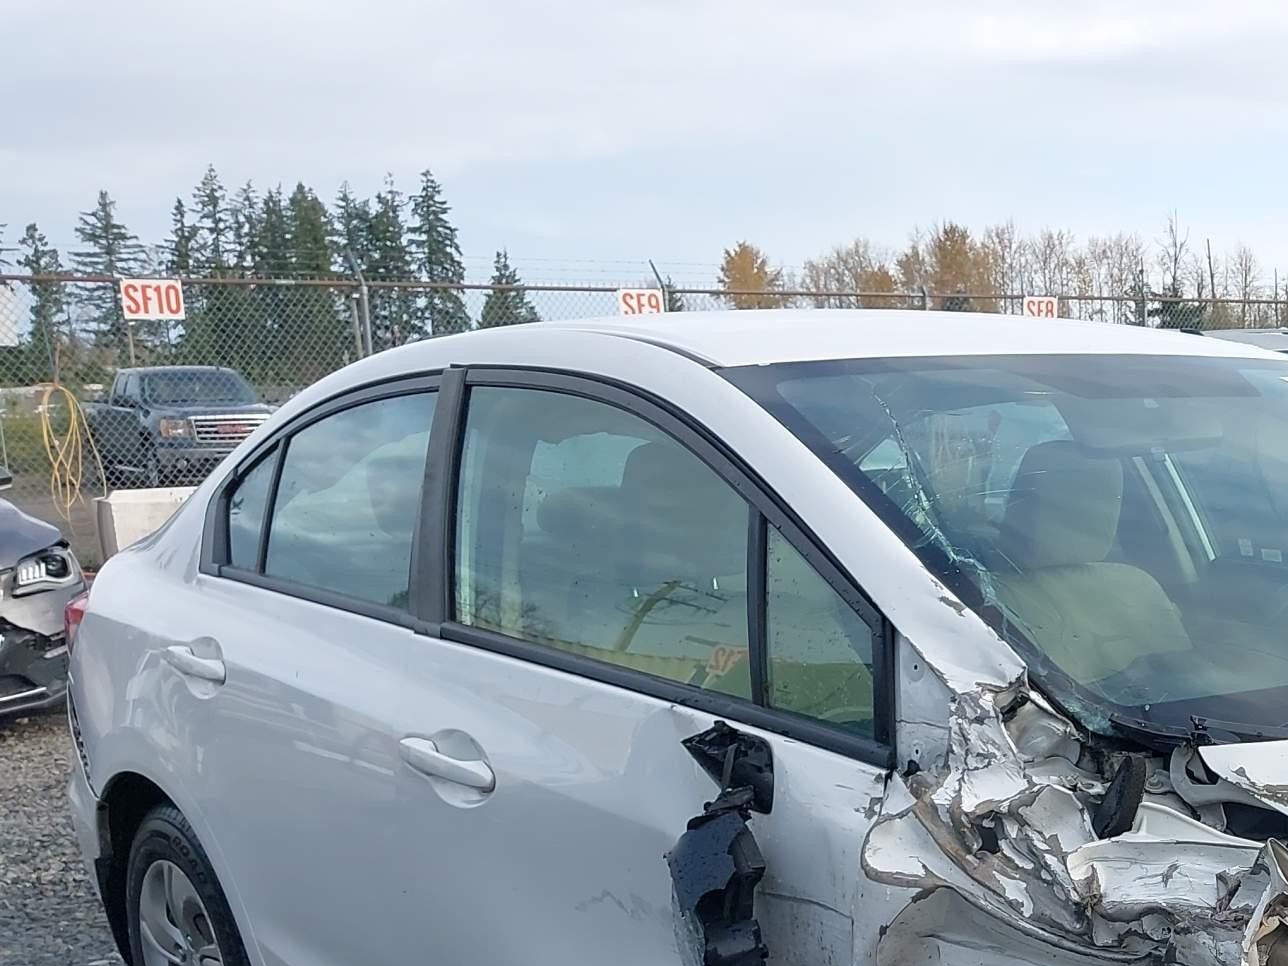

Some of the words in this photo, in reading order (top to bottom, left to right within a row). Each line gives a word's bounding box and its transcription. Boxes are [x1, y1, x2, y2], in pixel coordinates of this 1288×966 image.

[123, 283, 181, 315] SF10
[621, 292, 661, 315] SF9
[1026, 300, 1055, 318] SF8
